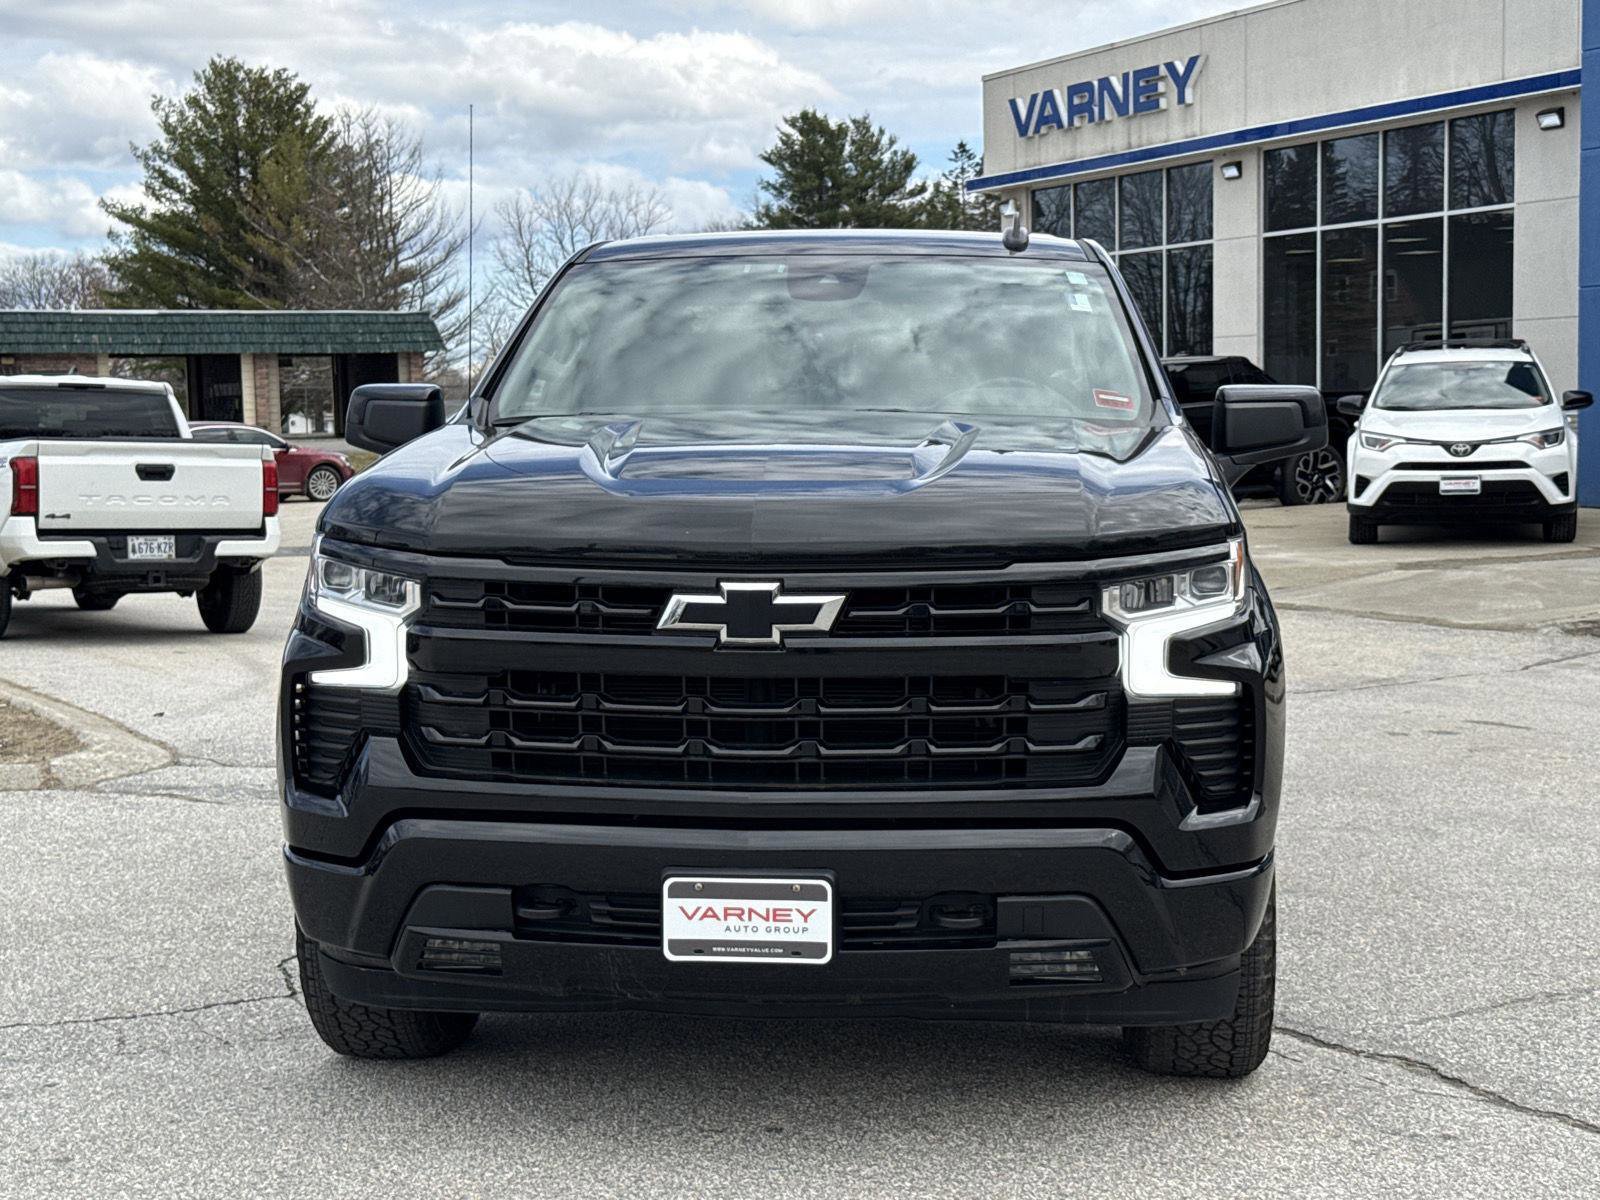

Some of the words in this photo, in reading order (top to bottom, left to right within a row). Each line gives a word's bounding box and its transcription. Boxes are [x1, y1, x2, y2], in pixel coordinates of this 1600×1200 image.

[1008, 55, 1203, 138] VARNEY
[79, 494, 231, 506] TACOMA
[678, 905, 818, 924] VARNEY
[724, 925, 759, 933] AUTO
[765, 926, 809, 934] GROUP
